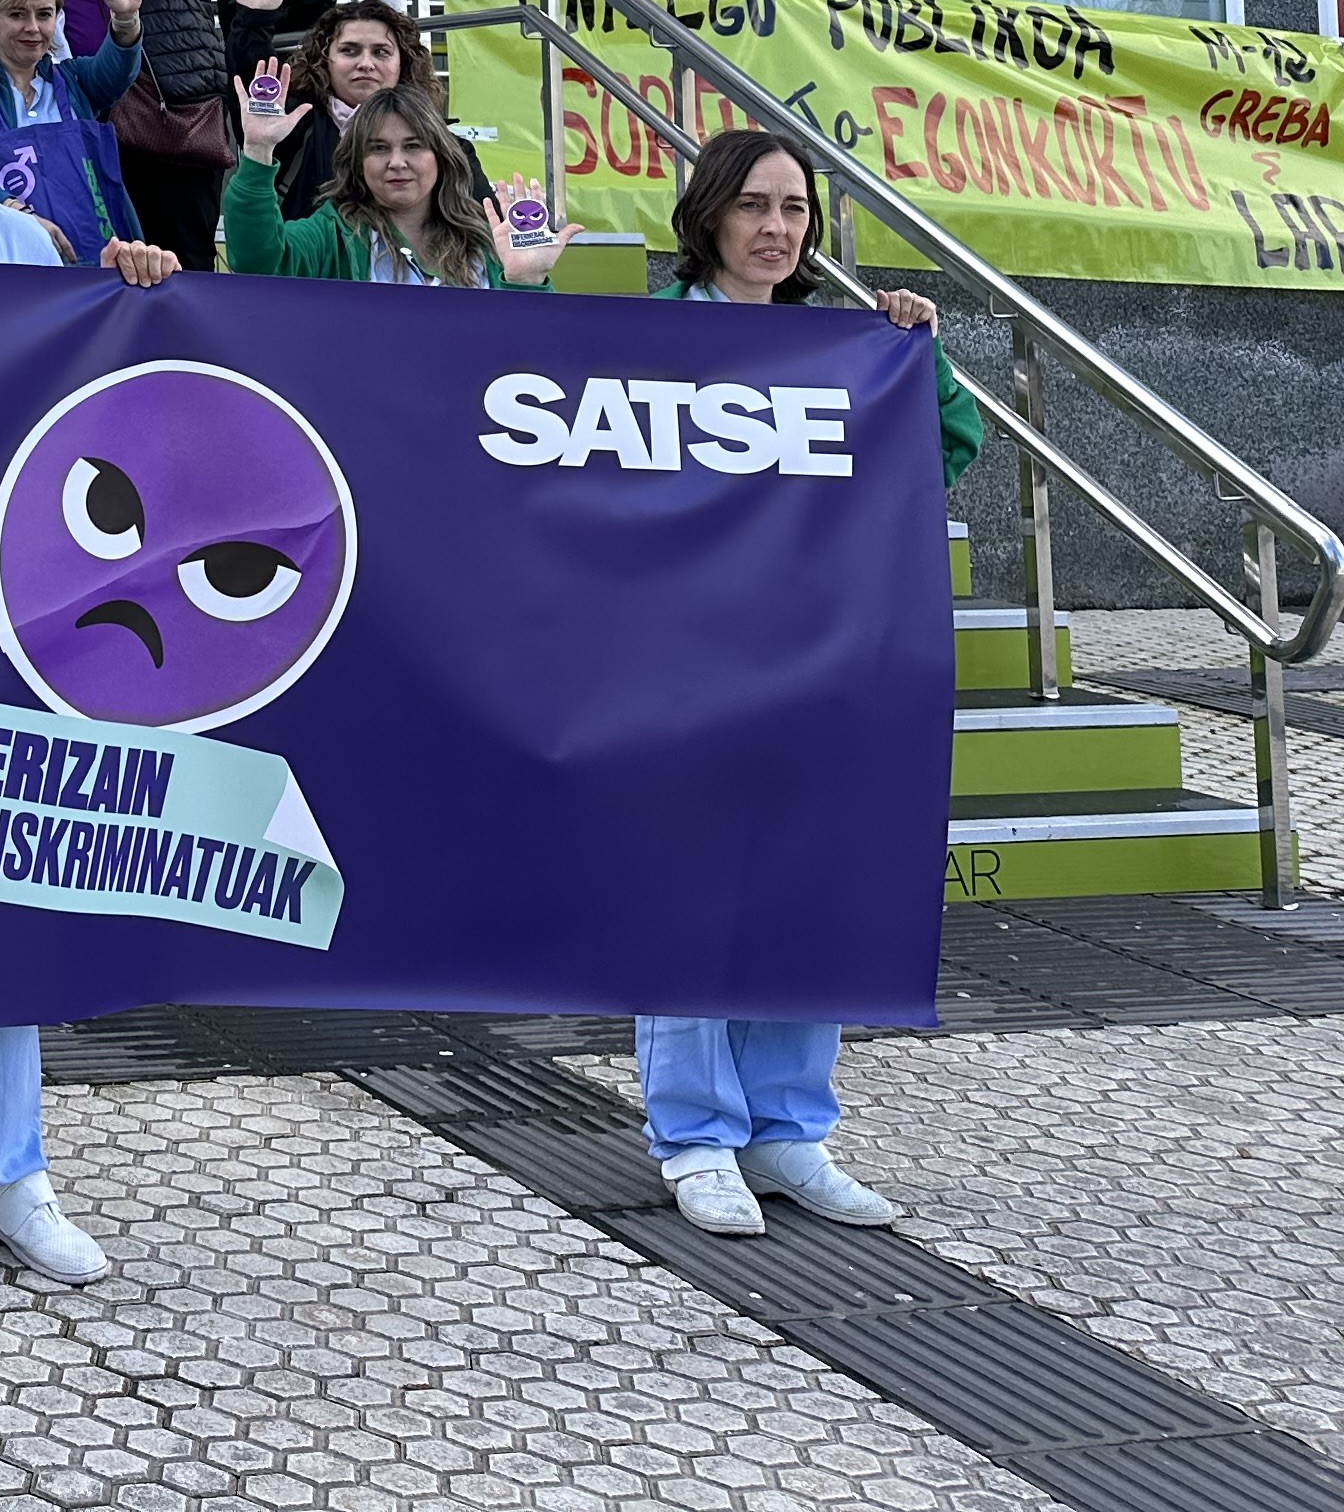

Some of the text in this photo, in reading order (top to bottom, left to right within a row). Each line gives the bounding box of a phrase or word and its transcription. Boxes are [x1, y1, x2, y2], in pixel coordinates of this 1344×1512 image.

[872, 86, 1210, 212] EGONKORTU
[1199, 88, 1331, 148] GREBA
[478, 372, 853, 477] SATSE
